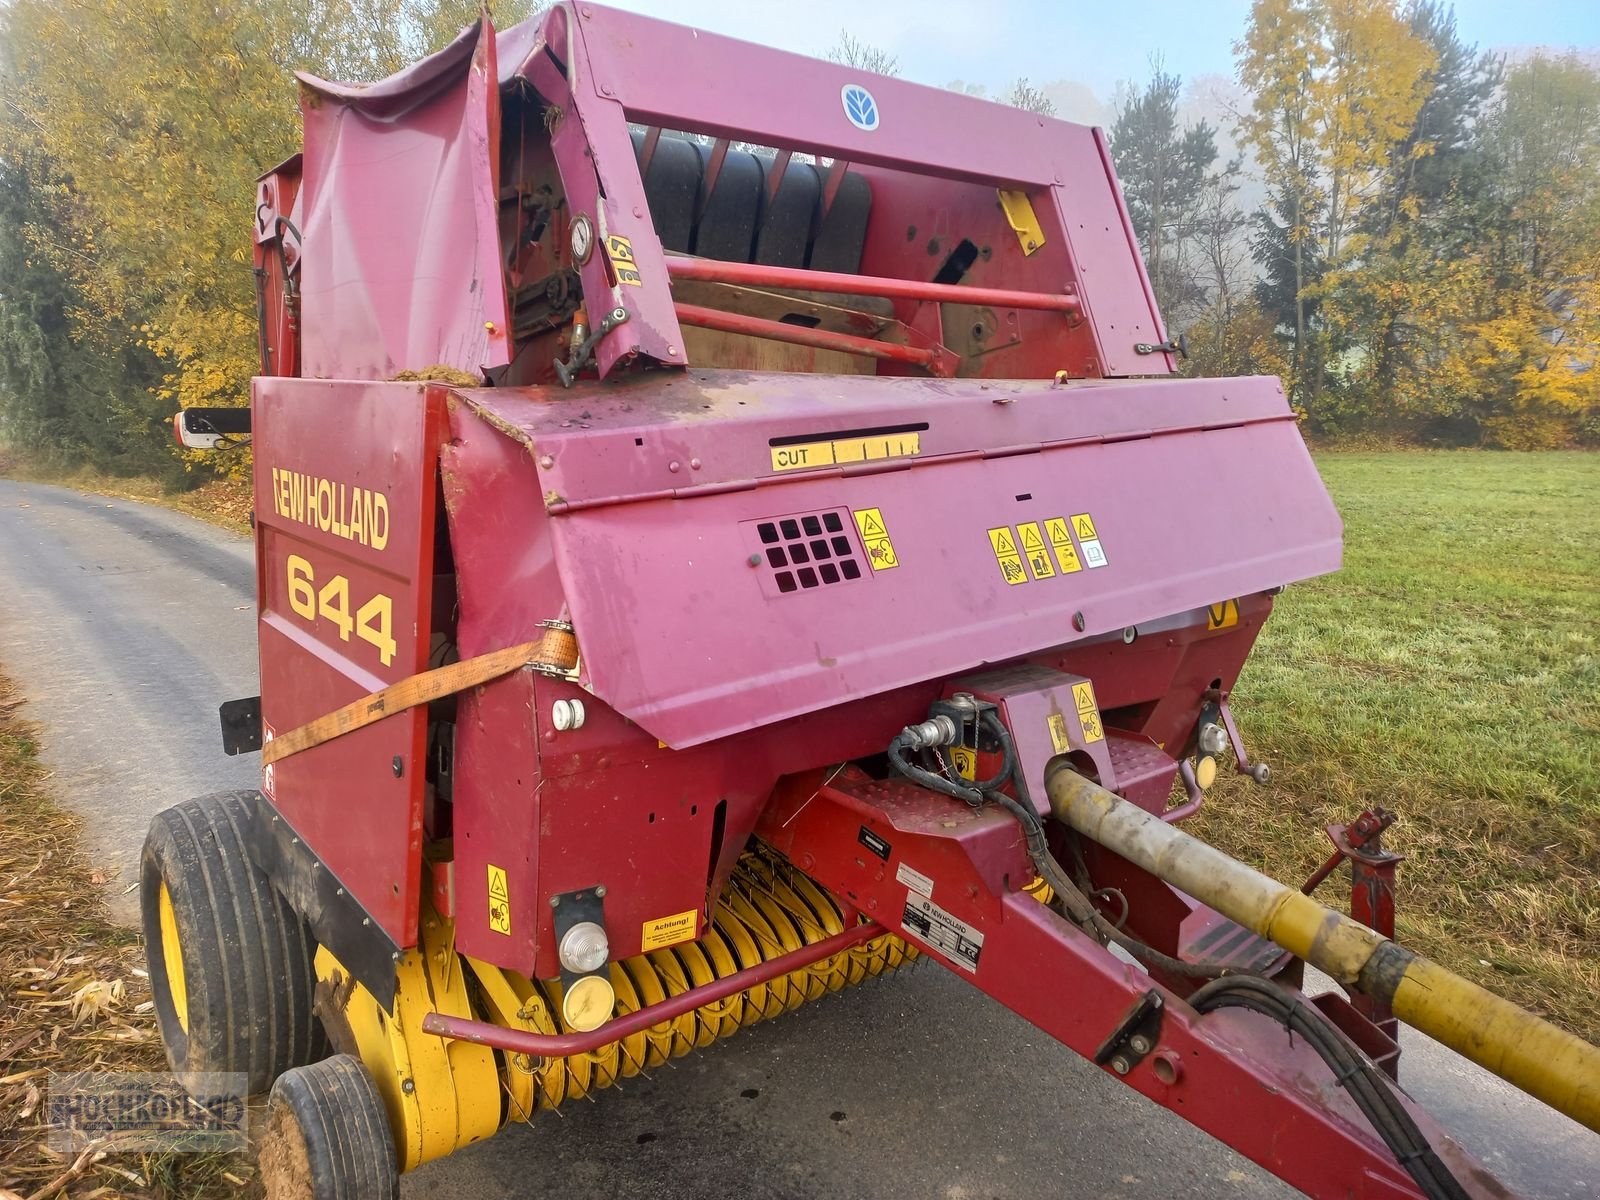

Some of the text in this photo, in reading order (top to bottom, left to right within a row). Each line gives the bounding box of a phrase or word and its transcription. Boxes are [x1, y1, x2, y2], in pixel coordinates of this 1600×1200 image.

[777, 449, 808, 466] CUT
[306, 475, 390, 551] HOLLAND
[287, 554, 396, 667] 644
[654, 917, 689, 931] Achtung!
[942, 914, 967, 934] HOLLAND
